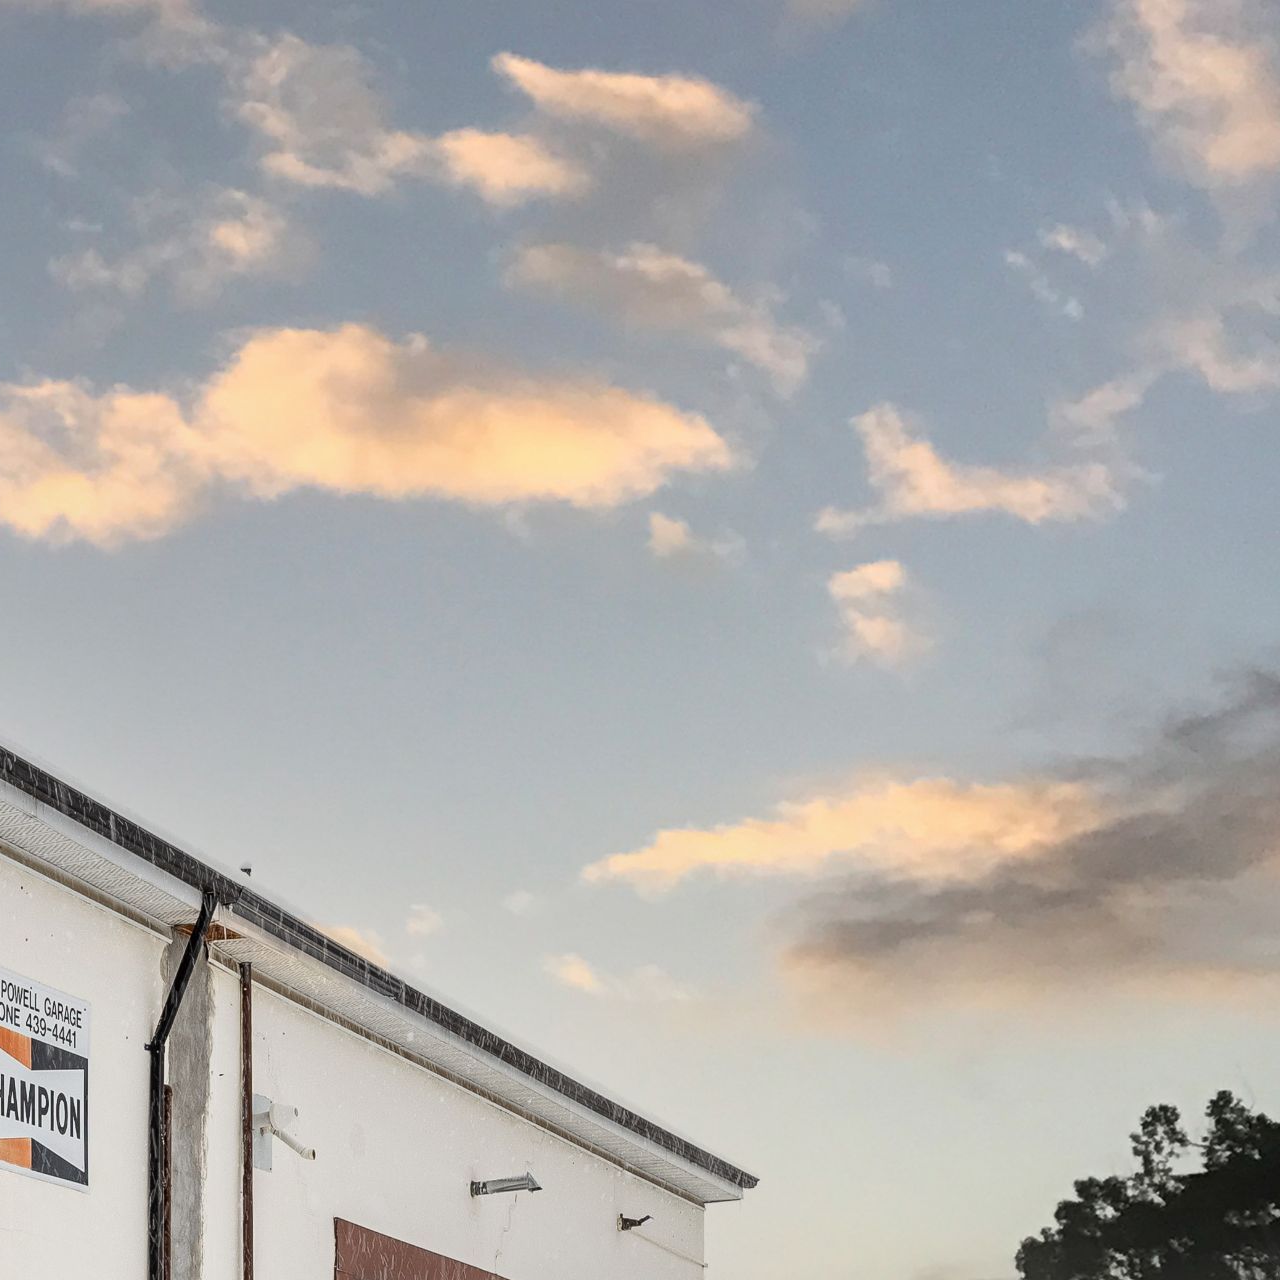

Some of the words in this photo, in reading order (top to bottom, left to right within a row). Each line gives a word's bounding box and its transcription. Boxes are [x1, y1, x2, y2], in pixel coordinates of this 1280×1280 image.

[1, 980, 40, 1012] POWELL
[44, 997, 82, 1029] GARAGE
[26, 1013, 77, 1048] 439-4441
